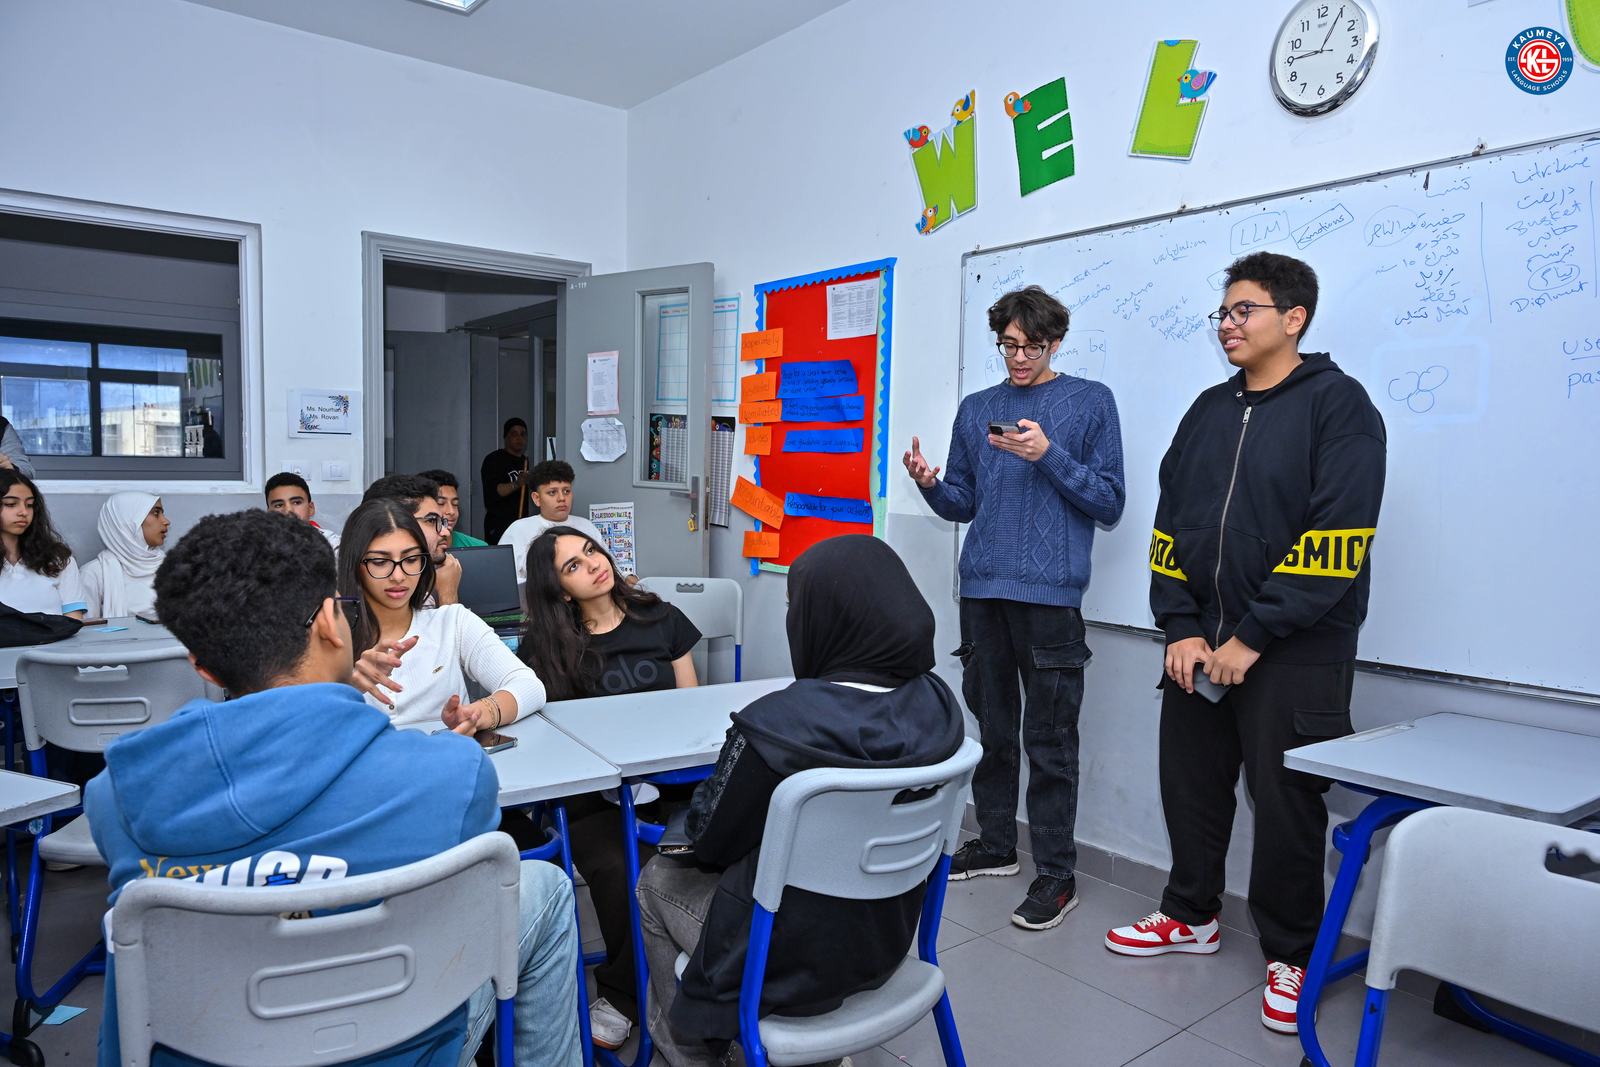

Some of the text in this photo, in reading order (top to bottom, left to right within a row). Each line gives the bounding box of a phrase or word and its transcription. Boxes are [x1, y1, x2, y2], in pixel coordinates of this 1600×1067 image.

[1317, 5, 1329, 19] 12
[1301, 20, 1310, 32] 11
[1347, 19, 1355, 32] 2
[1290, 38, 1302, 51] 10
[1351, 35, 1359, 47] 3
[1287, 56, 1295, 67] 9
[1346, 53, 1354, 64] 4
[1289, 71, 1298, 82] 8
[1336, 72, 1344, 84] 5
[1300, 83, 1307, 94] 7
[1317, 85, 1325, 96] 6
[1240, 220, 1281, 245] LLM
[602, 654, 658, 693] alo
